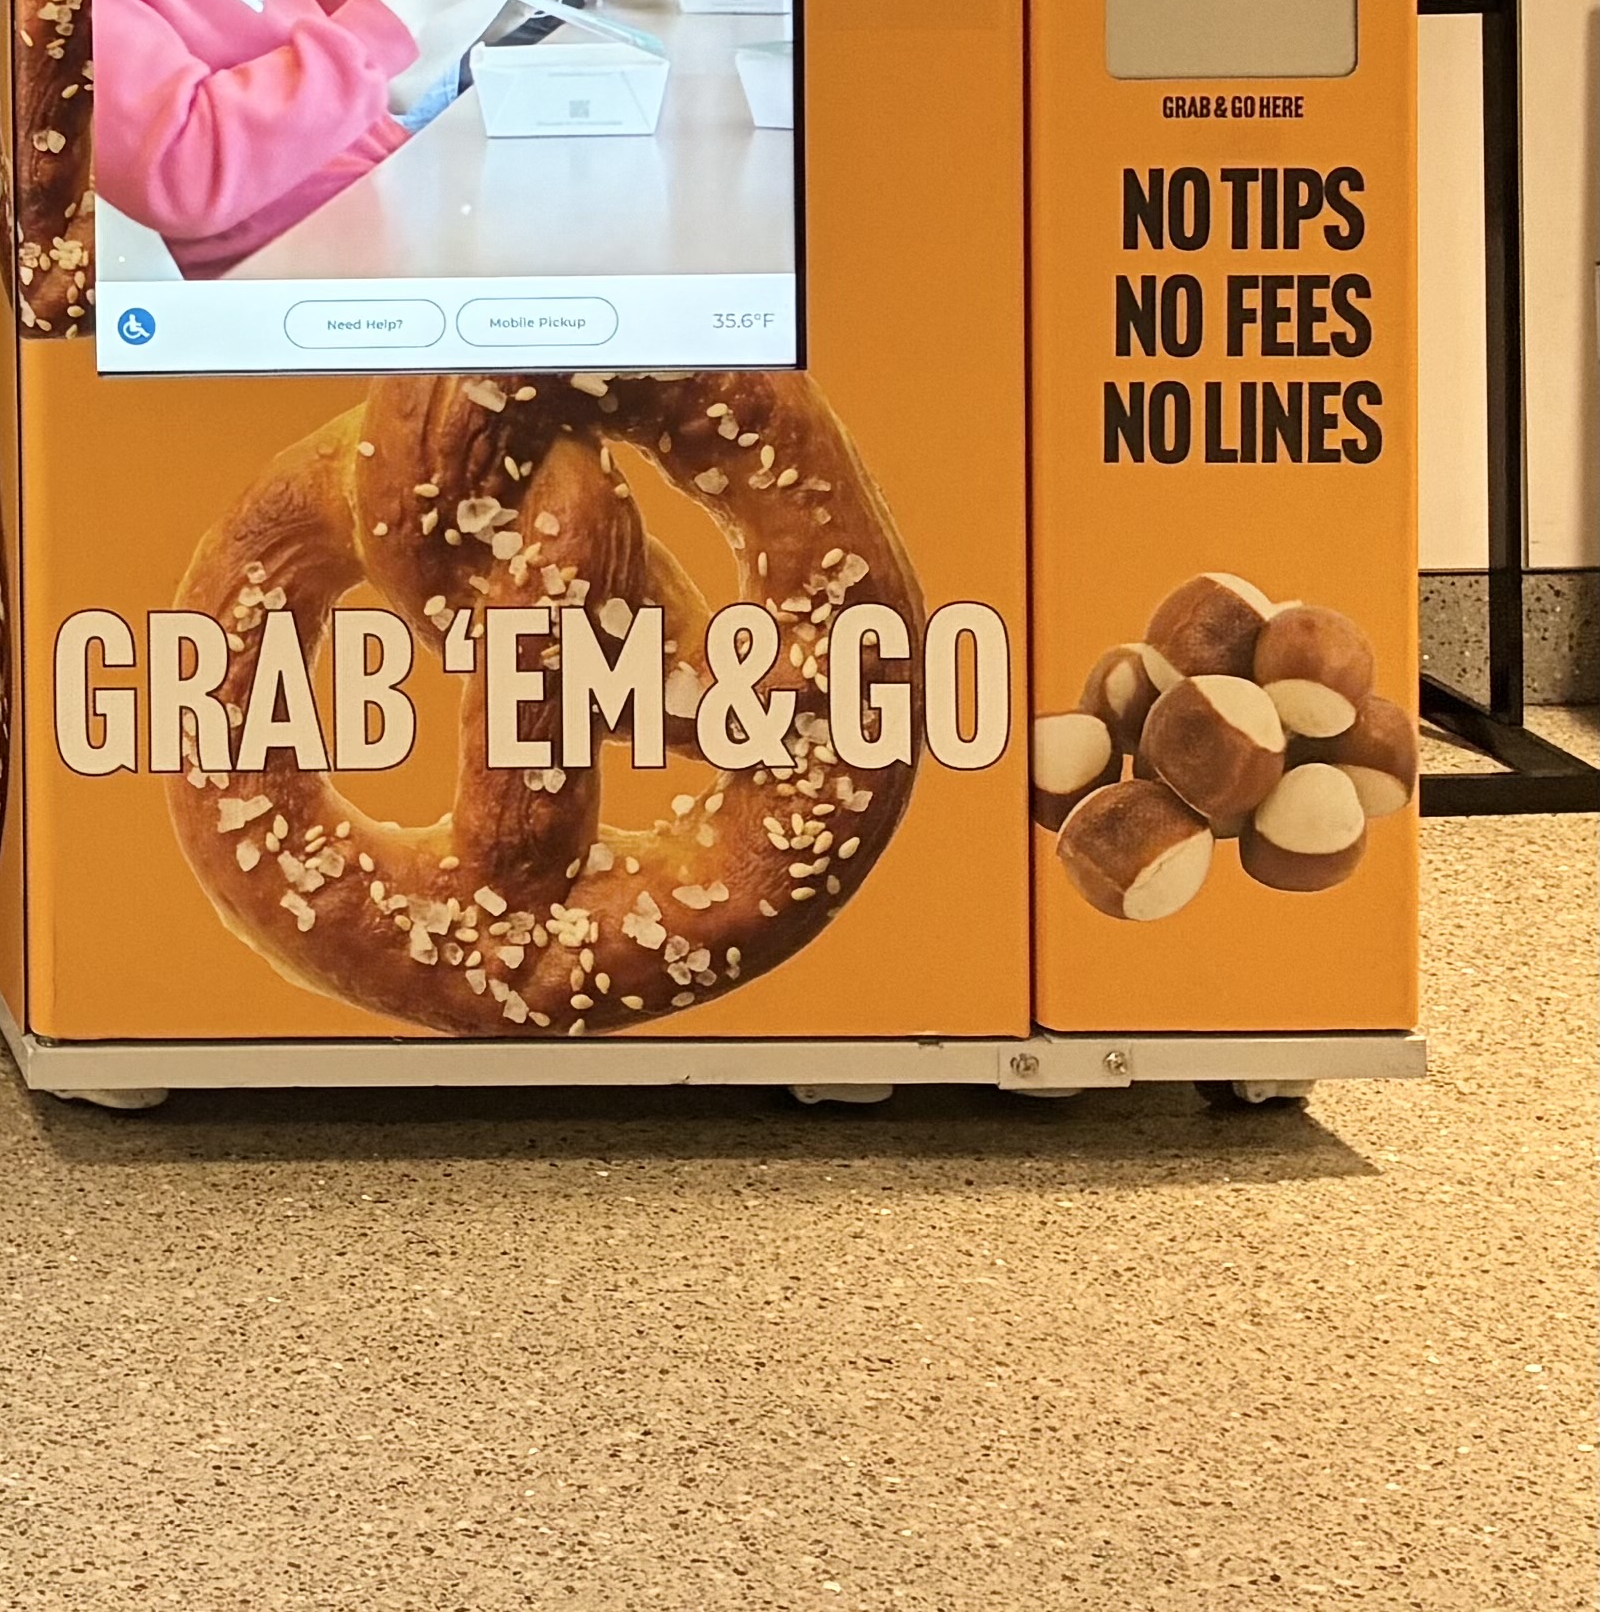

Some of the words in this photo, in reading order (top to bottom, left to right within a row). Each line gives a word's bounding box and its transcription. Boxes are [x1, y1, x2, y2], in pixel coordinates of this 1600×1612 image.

[1162, 96, 1211, 119] GRAB
[1213, 97, 1229, 119] &
[1231, 96, 1256, 118] GO
[1259, 96, 1304, 118] HERE
[1123, 167, 1210, 251] NO
[1220, 167, 1366, 251] TIPS
[327, 318, 362, 330] Need
[366, 316, 403, 332] Help?
[489, 315, 535, 329] Mobile
[538, 314, 586, 331] Pickup
[713, 313, 776, 330] 35.6°F
[1115, 274, 1202, 357] NO
[1227, 274, 1372, 357] FEES
[1103, 381, 1190, 465] NO
[1205, 381, 1383, 465] LINES
[52, 607, 415, 775] GRAB
[695, 602, 797, 770] &
[826, 600, 1012, 771] GO
